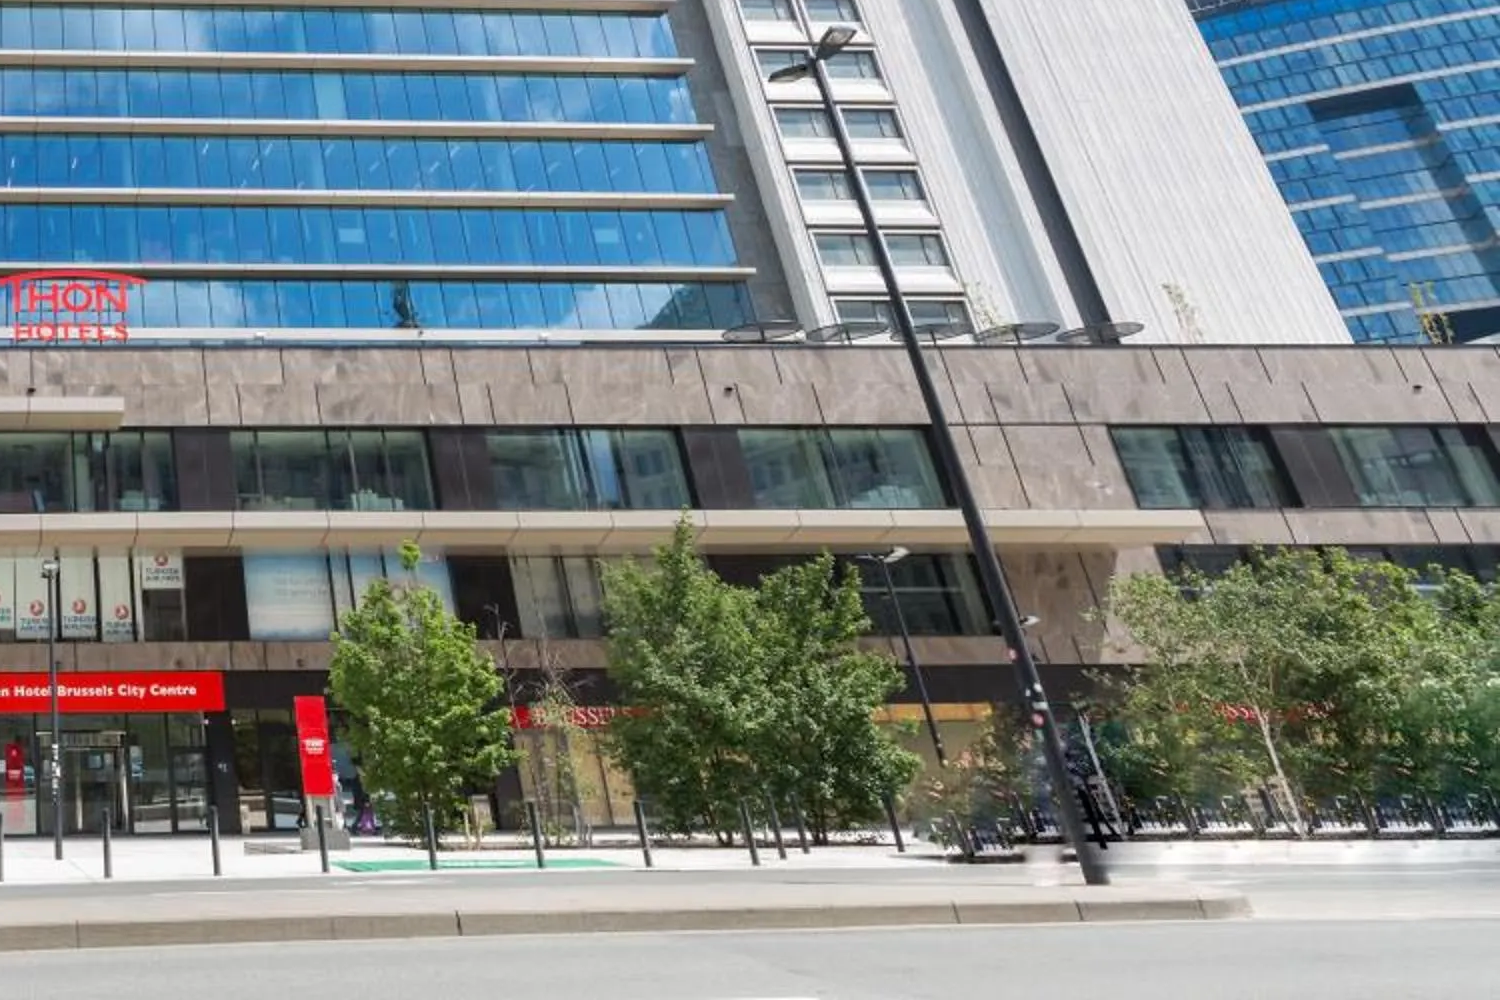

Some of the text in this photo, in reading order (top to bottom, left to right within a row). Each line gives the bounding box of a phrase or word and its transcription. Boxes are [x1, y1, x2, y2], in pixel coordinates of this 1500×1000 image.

[13, 319, 129, 342] HOTELS
[57, 685, 113, 697] Brussels
[118, 684, 146, 699] City
[150, 684, 197, 696] Centre
